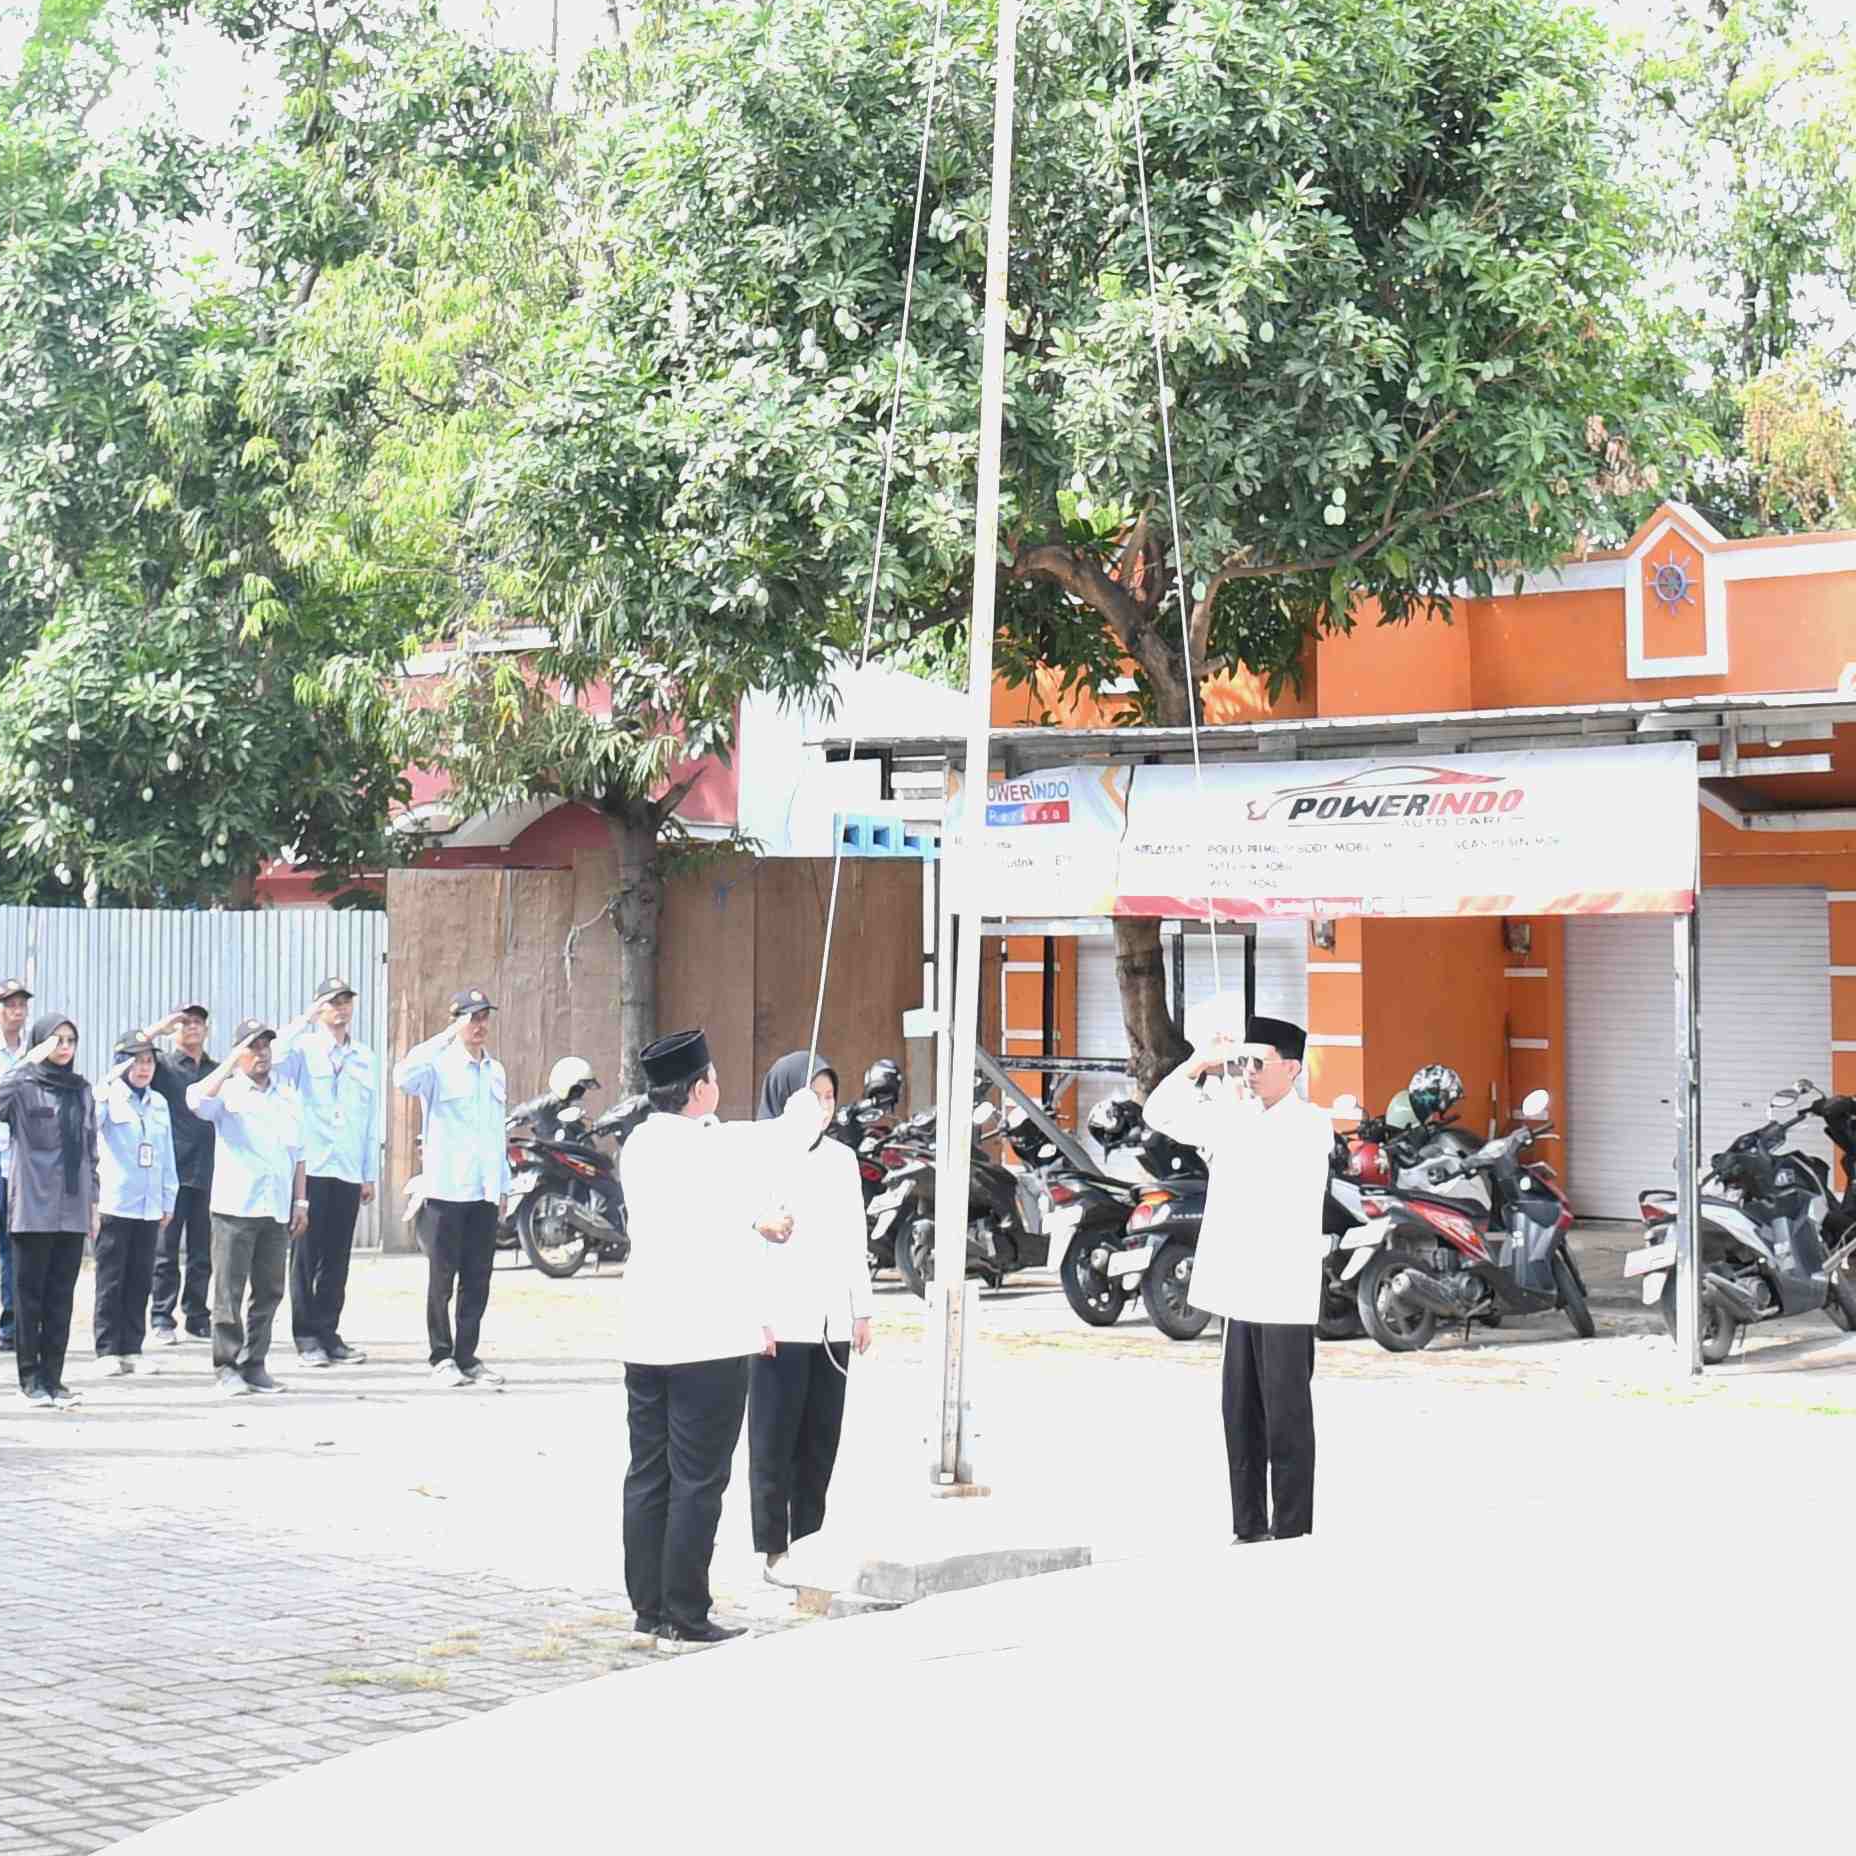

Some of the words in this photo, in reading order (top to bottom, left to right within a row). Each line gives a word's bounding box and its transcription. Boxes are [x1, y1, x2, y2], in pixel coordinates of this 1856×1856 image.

[987, 779, 1070, 802] OWERINDO
[988, 809, 1064, 823] Perasa
[1288, 789, 1526, 820] POWERINDO
